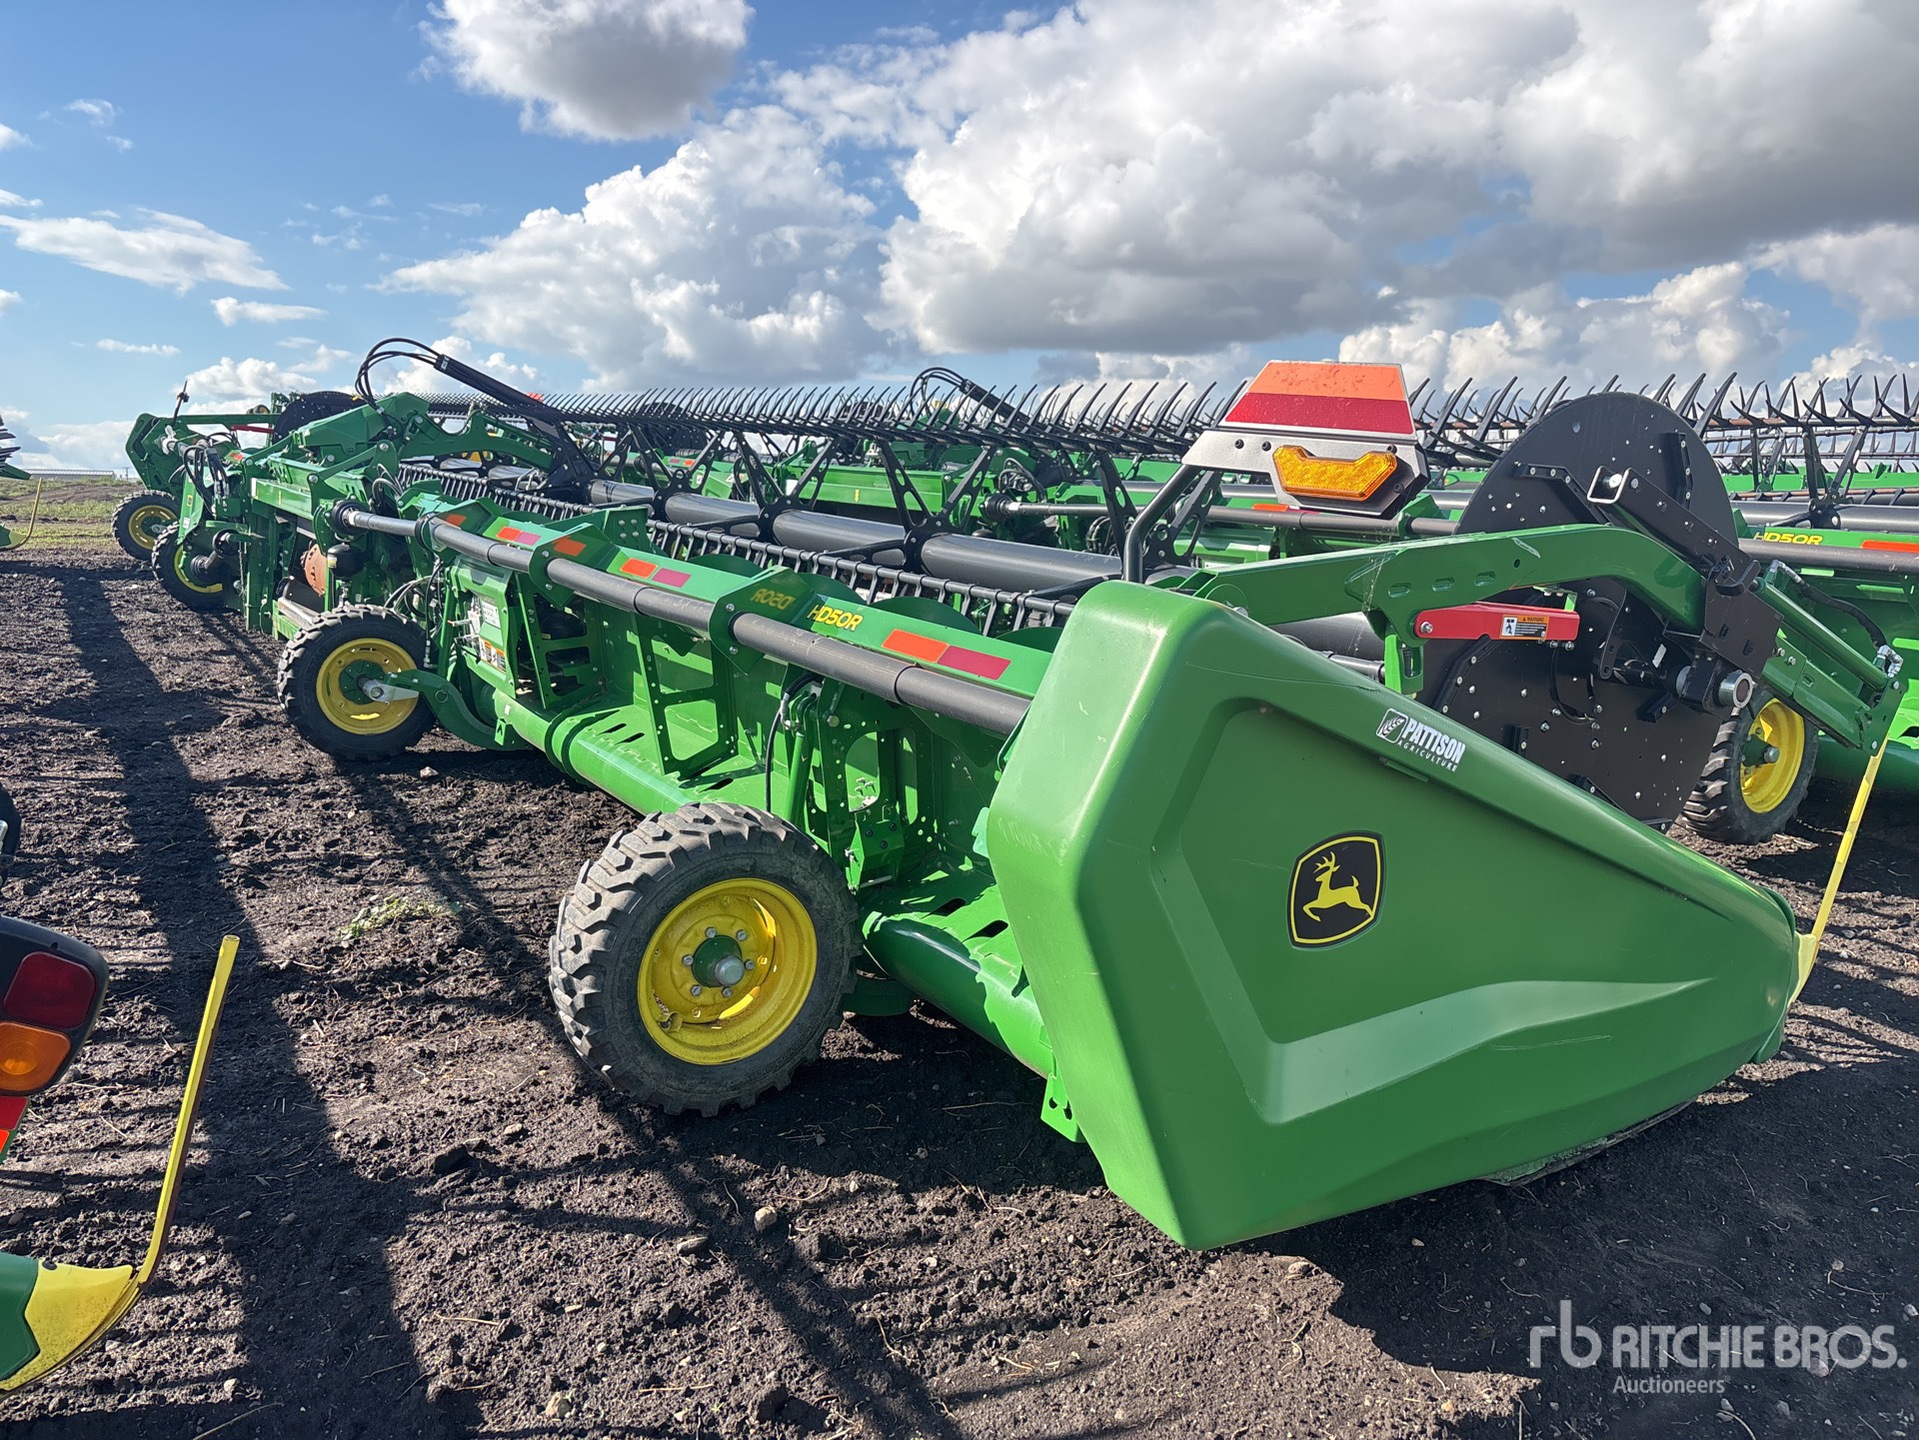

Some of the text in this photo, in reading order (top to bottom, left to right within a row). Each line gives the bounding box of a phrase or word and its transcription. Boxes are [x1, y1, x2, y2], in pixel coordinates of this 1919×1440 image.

[806, 604, 864, 631] HD50R
[1397, 740, 1458, 773] AGRICULTURE
[1401, 717, 1466, 764] PATTISON
